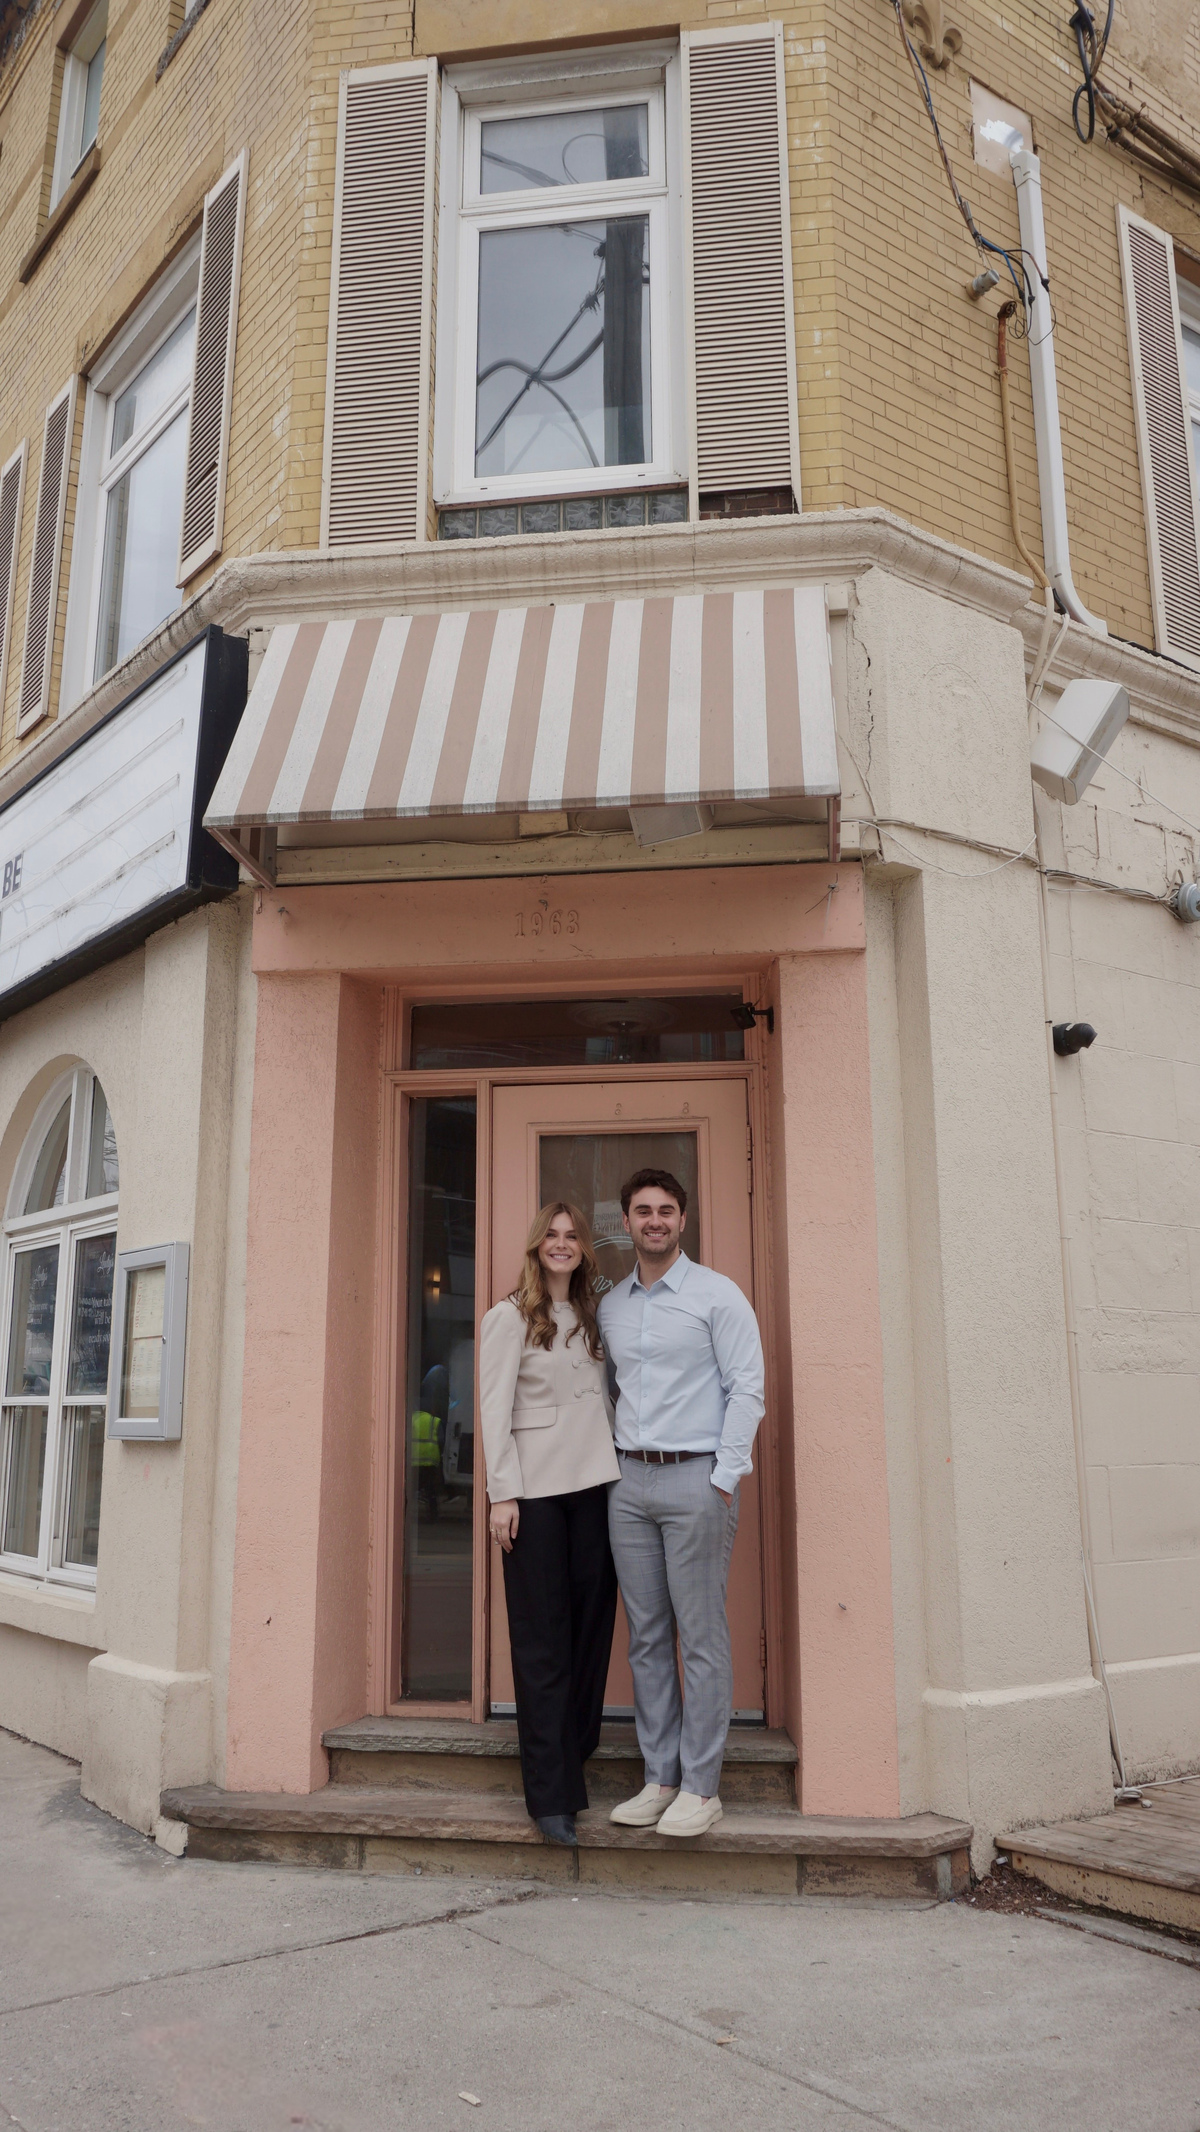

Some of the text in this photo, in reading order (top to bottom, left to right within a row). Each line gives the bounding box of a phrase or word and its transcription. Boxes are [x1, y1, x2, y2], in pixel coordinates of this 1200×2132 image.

[2, 853, 23, 899] BE
[514, 909, 580, 937] 1963
[104, 1293, 112, 1306] tab
